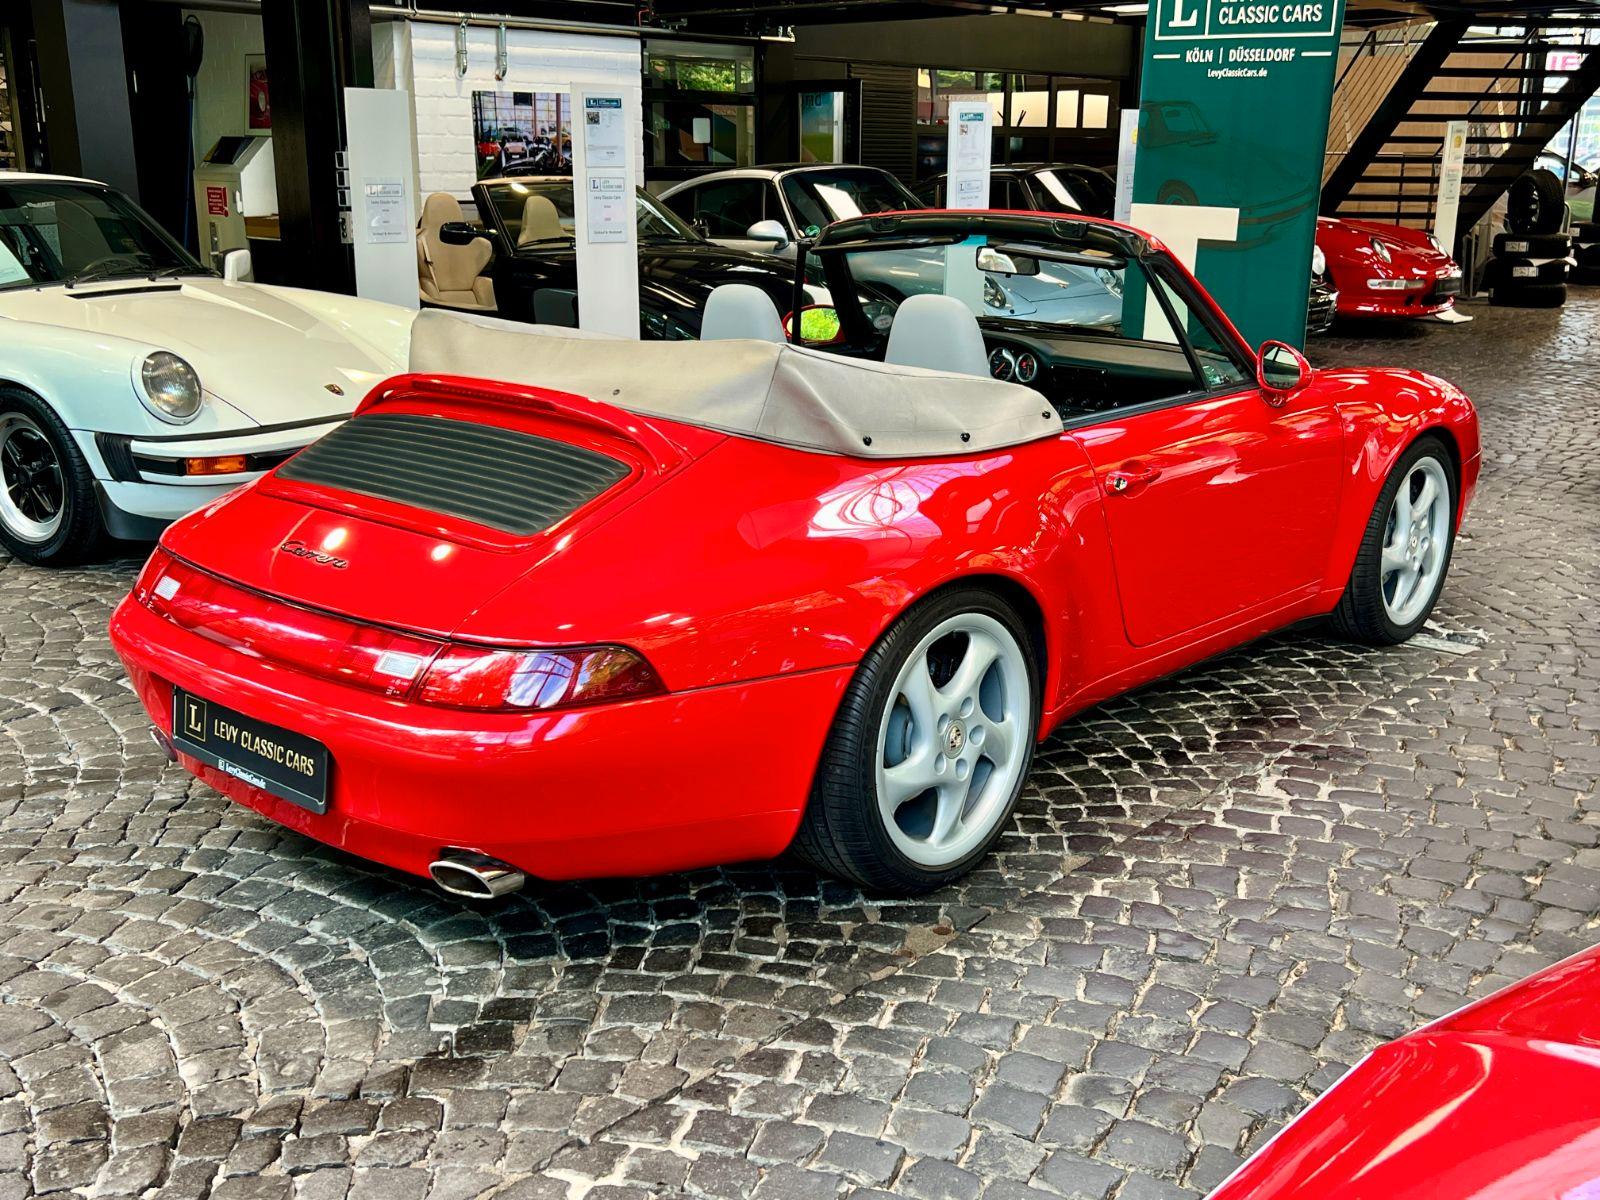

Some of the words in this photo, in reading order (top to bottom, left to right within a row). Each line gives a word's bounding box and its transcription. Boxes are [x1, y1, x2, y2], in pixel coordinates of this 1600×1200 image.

[1218, 5, 1279, 25] CLASSIC
[1282, 4, 1323, 23] CARS
[1185, 47, 1213, 63] KÖLN
[1228, 46, 1296, 63] DÜSSELDORF
[1207, 67, 1268, 79] LevyClassicCars.de
[281, 540, 347, 568] Carrera
[189, 704, 201, 732] L
[214, 718, 238, 744] LEVY
[241, 731, 284, 764] CLASSIC
[286, 749, 314, 777] CARS
